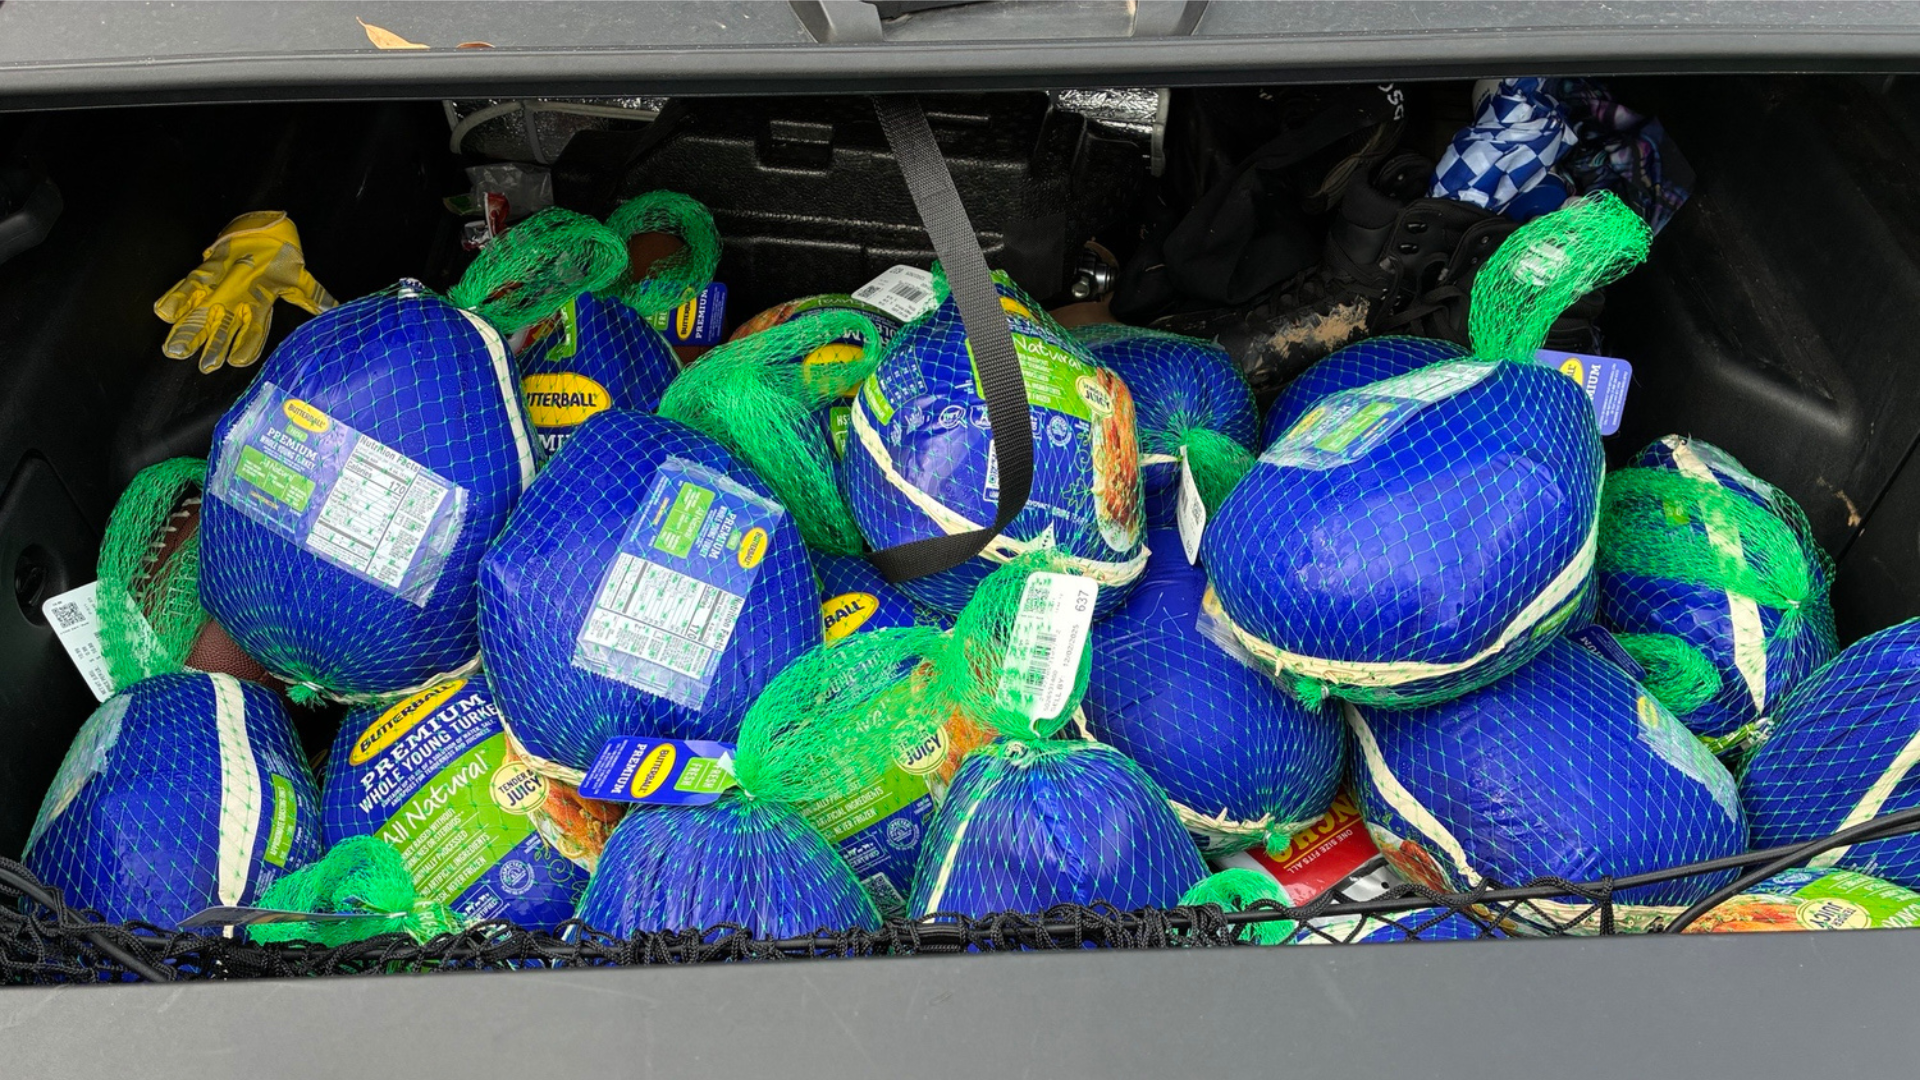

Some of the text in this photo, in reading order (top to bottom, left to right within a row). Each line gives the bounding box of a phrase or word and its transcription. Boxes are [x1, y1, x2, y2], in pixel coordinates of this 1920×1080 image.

[696, 289, 708, 338] PREMIUM
[528, 392, 596, 409] TTERBALL
[1587, 364, 1601, 400] MIUM
[286, 402, 325, 428] BUTTERBALL
[266, 426, 318, 460] PREMIUM
[387, 479, 406, 496] 170
[709, 513, 737, 560] PREMIUM
[1073, 589, 1090, 613] 637
[687, 623, 700, 640] 170
[359, 684, 457, 753] BUTTERBALL
[358, 703, 499, 814] WHOLE YOUNG TURKE
[360, 694, 486, 792] PREMIUM
[906, 733, 942, 766] JUICY
[498, 772, 528, 794] TENDER
[611, 743, 648, 794] PREMIUM
[638, 749, 669, 793] BUTTERBALL
[381, 751, 492, 846] All Natural
[507, 777, 542, 806] JUICY
[1269, 792, 1359, 863] NCHO
[1285, 827, 1353, 875] ONE SIZE FITS ALL
